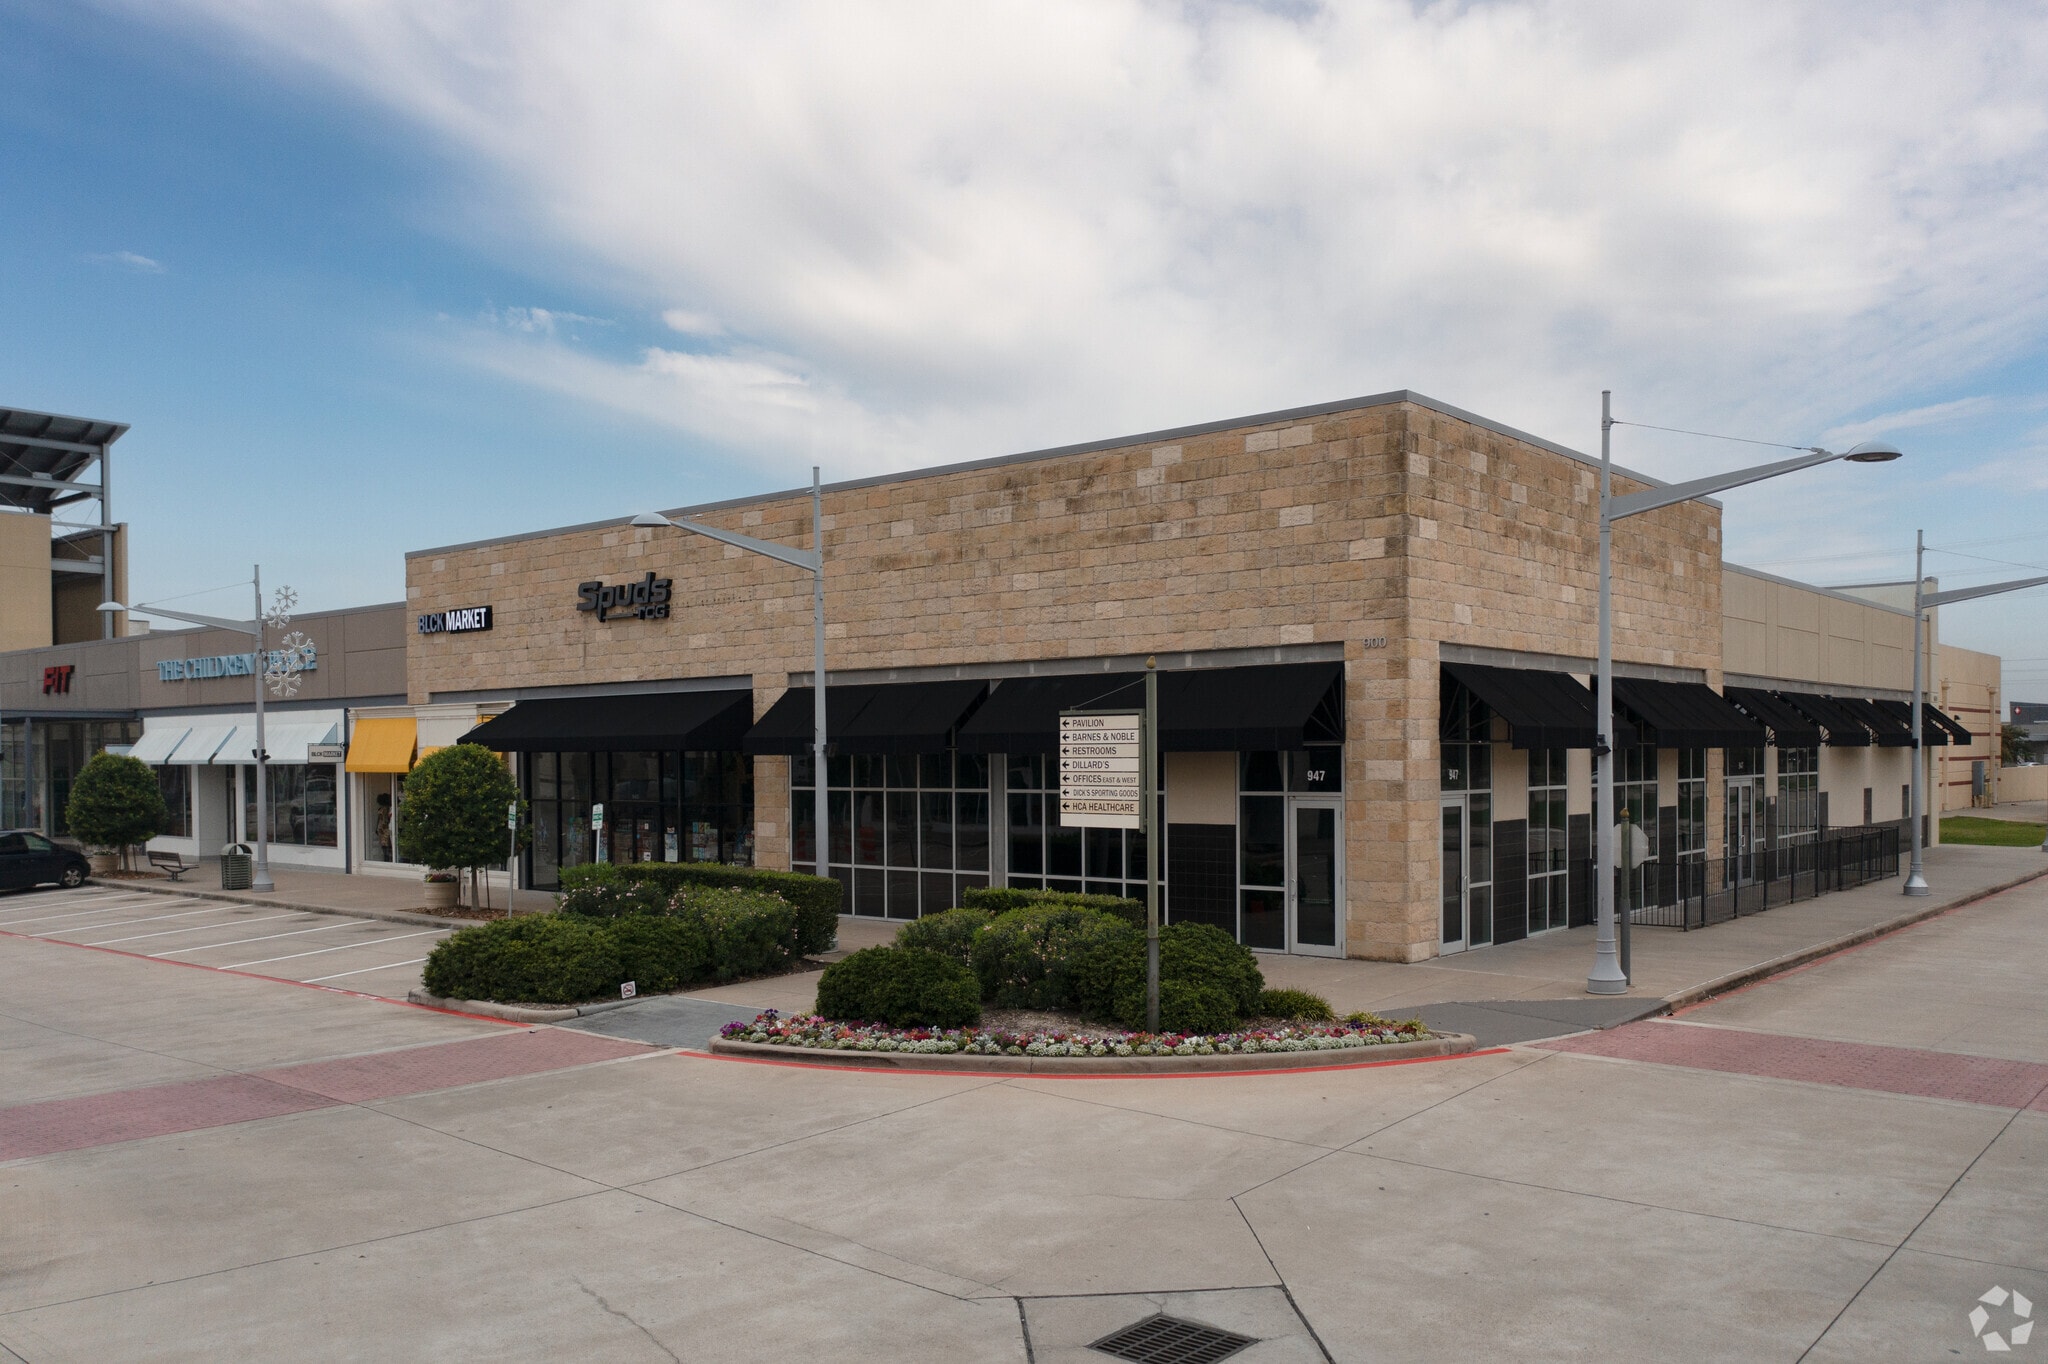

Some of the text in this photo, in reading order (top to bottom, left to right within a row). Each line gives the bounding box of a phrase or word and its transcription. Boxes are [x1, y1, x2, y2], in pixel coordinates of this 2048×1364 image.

[577, 572, 673, 622] Spuds
[418, 607, 487, 634] BLCK MARKET
[1363, 637, 1387, 649] 900
[157, 659, 184, 681] THE
[42, 665, 75, 695] FIT
[1072, 719, 1104, 727] PAVILION
[1072, 732, 1135, 741] BARNES & NOBLE
[1072, 747, 1117, 755] RESTROOMS
[1072, 761, 1109, 769] DILLARD'S
[1073, 775, 1101, 783] OFFICES
[1307, 770, 1326, 781] 947
[1073, 789, 1090, 797] DICK'S
[1091, 789, 1118, 797] SPORTING
[1072, 802, 1135, 812] HCA HEALTHCARE
